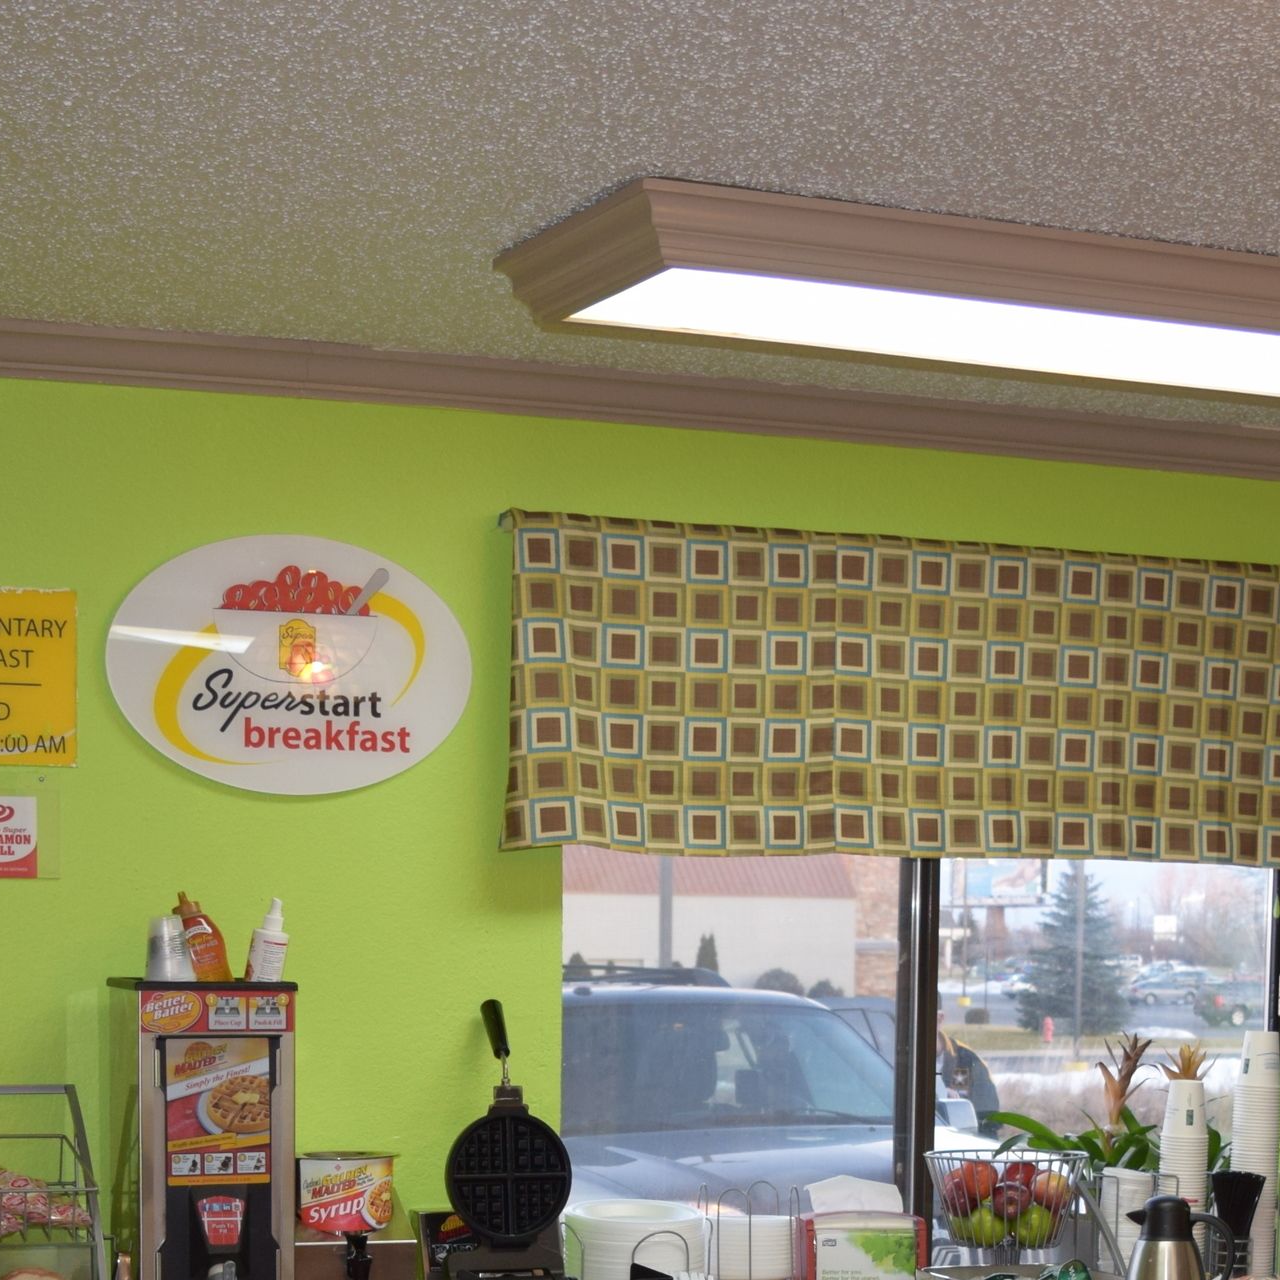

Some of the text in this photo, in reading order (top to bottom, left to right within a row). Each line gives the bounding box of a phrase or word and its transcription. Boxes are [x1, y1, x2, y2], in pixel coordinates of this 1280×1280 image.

[34, 734, 67, 754] AM
[243, 717, 411, 753] breakfast
[3, 826, 27, 834] Super
[145, 995, 186, 1012] Better
[154, 1002, 194, 1020] Batter
[175, 1055, 218, 1077] MALTED
[184, 1065, 252, 1091] Simply the Finest!
[311, 1179, 357, 1200] MALTED
[308, 1197, 365, 1224] Syrup
